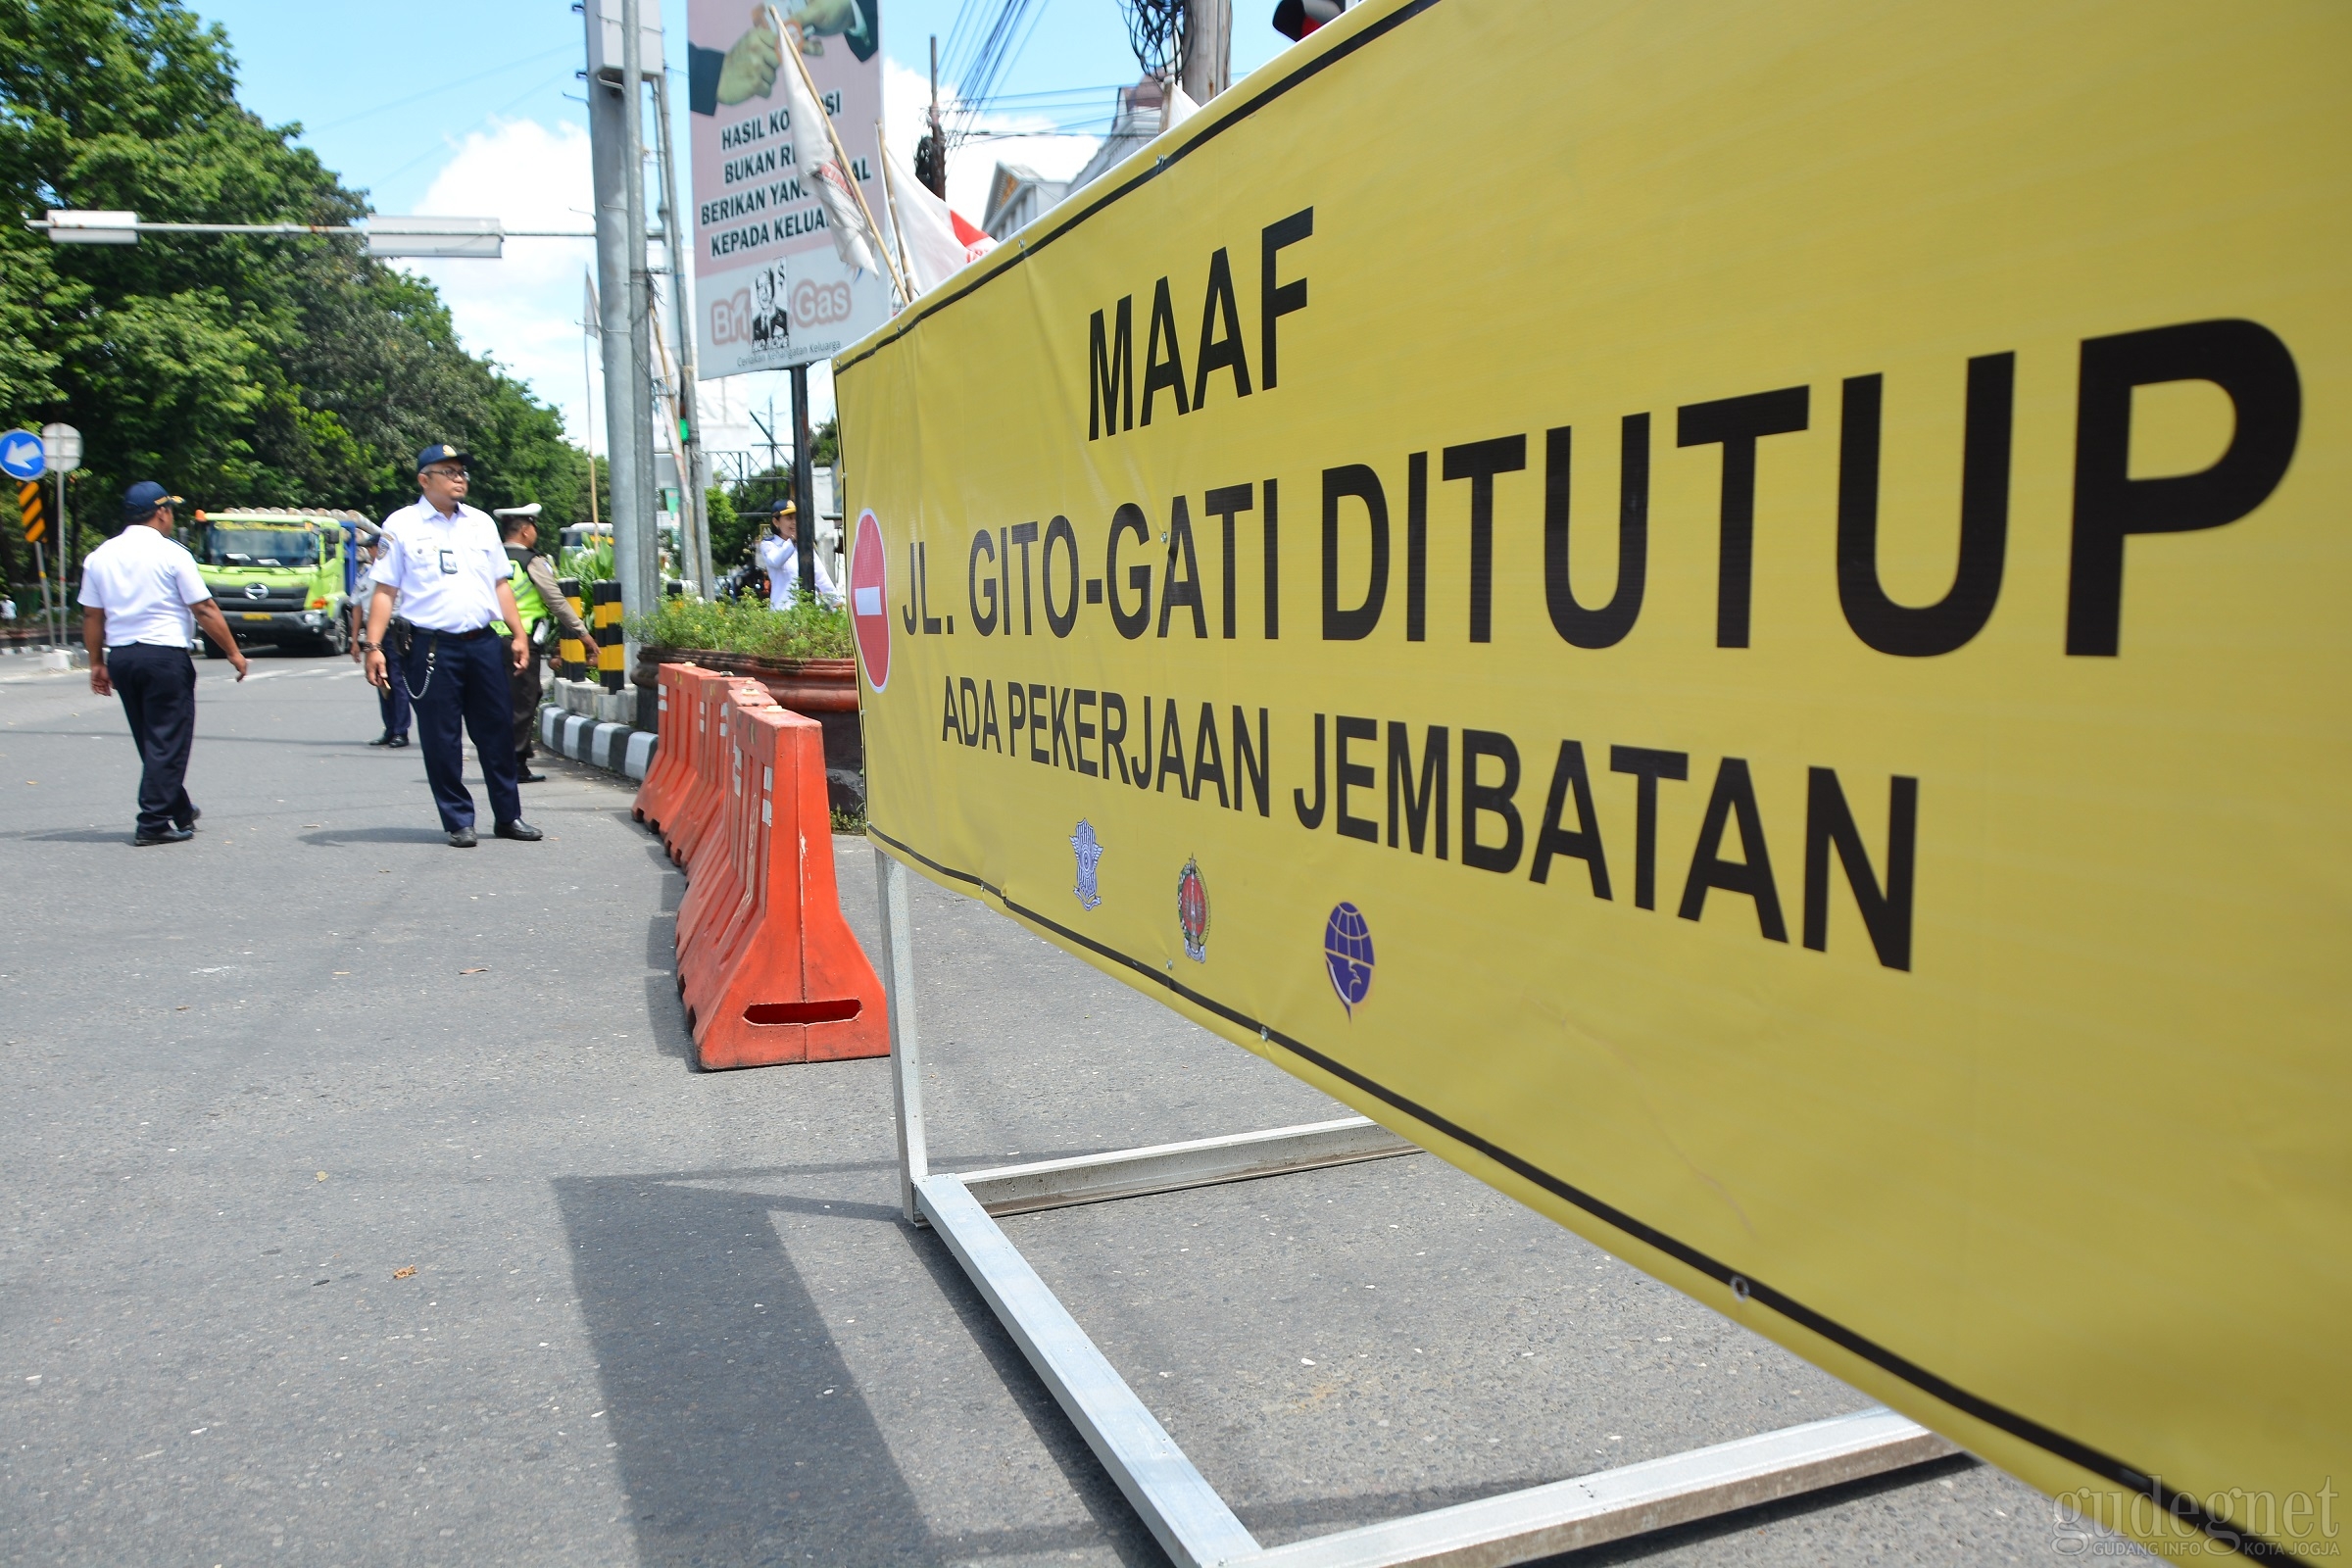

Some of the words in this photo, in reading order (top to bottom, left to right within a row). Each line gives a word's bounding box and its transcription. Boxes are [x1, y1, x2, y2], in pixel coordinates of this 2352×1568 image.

[721, 117, 765, 150] HASIL
[768, 90, 841, 135] KOSI
[724, 148, 775, 184] BUKAN
[701, 188, 765, 225] BERIKAN
[769, 176, 808, 205] YAN
[710, 223, 770, 257] KEPADA
[773, 207, 829, 240] KELUA
[794, 280, 851, 328] Gas
[1088, 205, 1314, 442] MAAF
[808, 340, 841, 354] Keluarga
[902, 541, 955, 636] JL.
[968, 477, 1279, 640] GITO-GATI
[1321, 318, 2303, 658] DITUTUP
[942, 675, 1003, 755] ADA
[1007, 681, 1270, 818] PEKERJAAN
[1293, 712, 1918, 973] JEMBATAN
